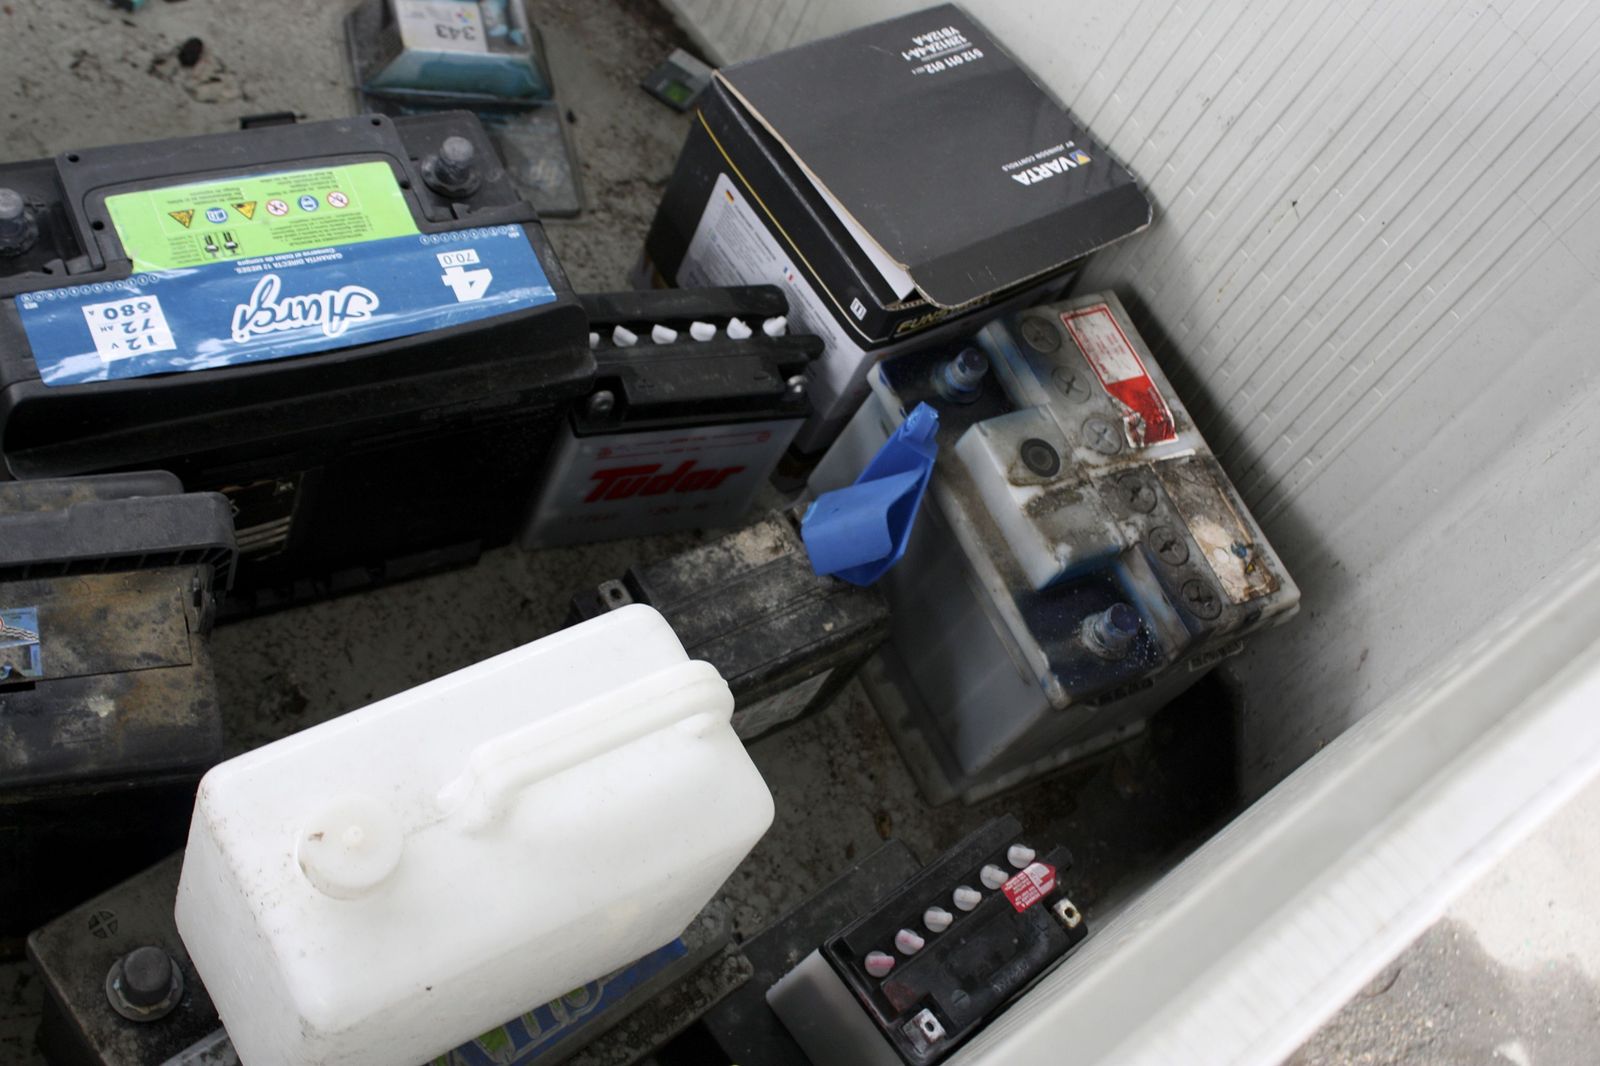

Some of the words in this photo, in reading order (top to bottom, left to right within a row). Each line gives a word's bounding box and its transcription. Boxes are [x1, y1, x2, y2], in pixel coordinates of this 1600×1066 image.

[434, 24, 476, 41] 343
[923, 60, 946, 74] 012
[1035, 144, 1065, 159] JOHNSON
[1001, 155, 1035, 172] CONTROLS
[1011, 156, 1077, 186] VARTA
[272, 257, 305, 269] DIRECTA
[305, 252, 343, 265] GARANTÍA
[442, 252, 475, 265] 70.0
[441, 266, 493, 303] 4
[102, 301, 152, 321] 680
[232, 274, 379, 343] Aurgi
[121, 318, 155, 335] 72
[110, 342, 120, 350] V
[125, 335, 158, 351] 12
[583, 459, 747, 503] Tudor
